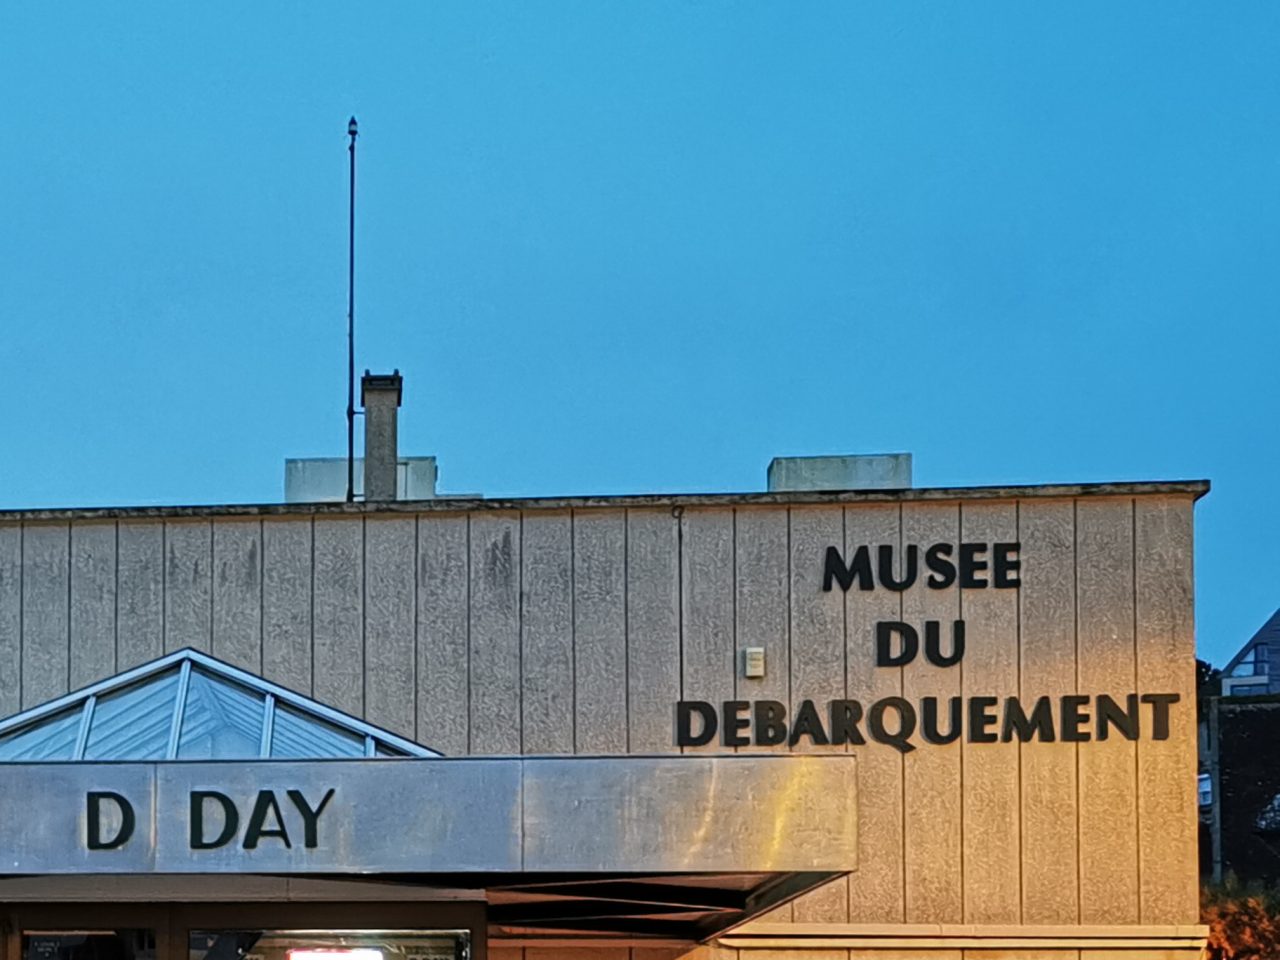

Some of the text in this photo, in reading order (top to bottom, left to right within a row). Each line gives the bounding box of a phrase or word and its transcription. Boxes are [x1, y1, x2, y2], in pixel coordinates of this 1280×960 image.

[822, 542, 1021, 592] MUSEE
[876, 620, 966, 667] DU
[676, 693, 1181, 752] DEBARQUEMENT
[86, 790, 136, 851] D
[189, 788, 336, 850] DAY
